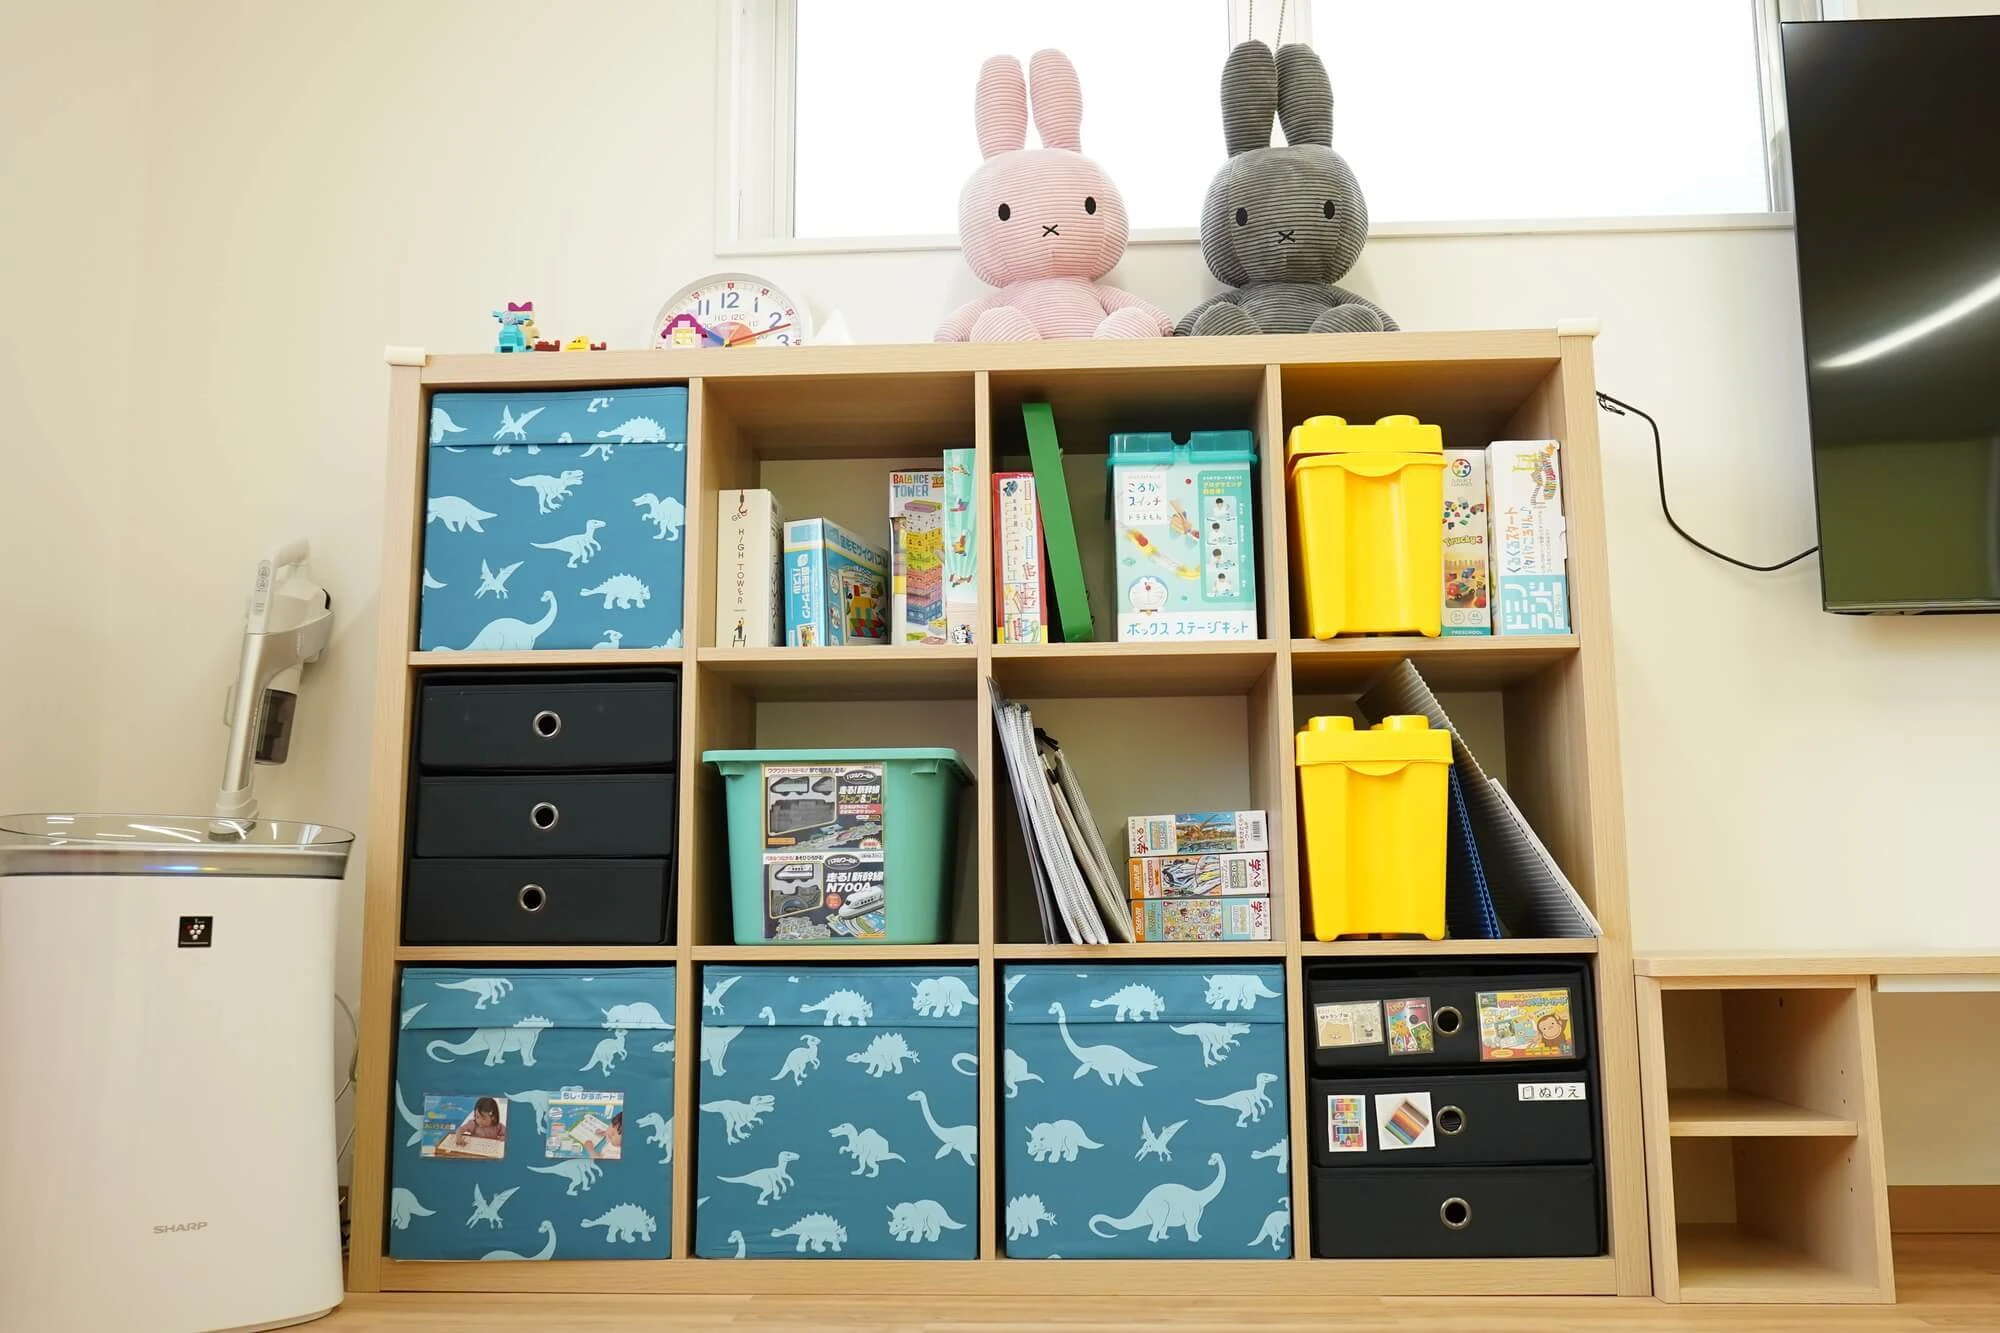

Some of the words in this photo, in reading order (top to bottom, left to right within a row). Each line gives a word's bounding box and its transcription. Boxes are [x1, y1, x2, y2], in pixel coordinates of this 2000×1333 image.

[698, 300, 710, 315] 11
[721, 292, 740, 309] 12
[753, 296, 759, 313] 1
[768, 312, 783, 329] 2
[893, 474, 929, 484] BALANCE
[893, 485, 929, 498] TOWER
[1128, 482, 1161, 493] ころが
[1129, 496, 1161, 507] スイッチ
[1128, 512, 1162, 521] ドラえもん
[737, 529, 745, 559] HIGH
[736, 563, 745, 605] TOWER
[1504, 583, 1530, 630] ドミノ
[1529, 582, 1553, 630] ランド
[1127, 622, 1169, 636] ボックス
[1175, 621, 1249, 635] ステージキット
[826, 882, 871, 893] N700A
[1539, 1085, 1580, 1098] ぬりえ
[153, 1221, 208, 1234] SHARP
